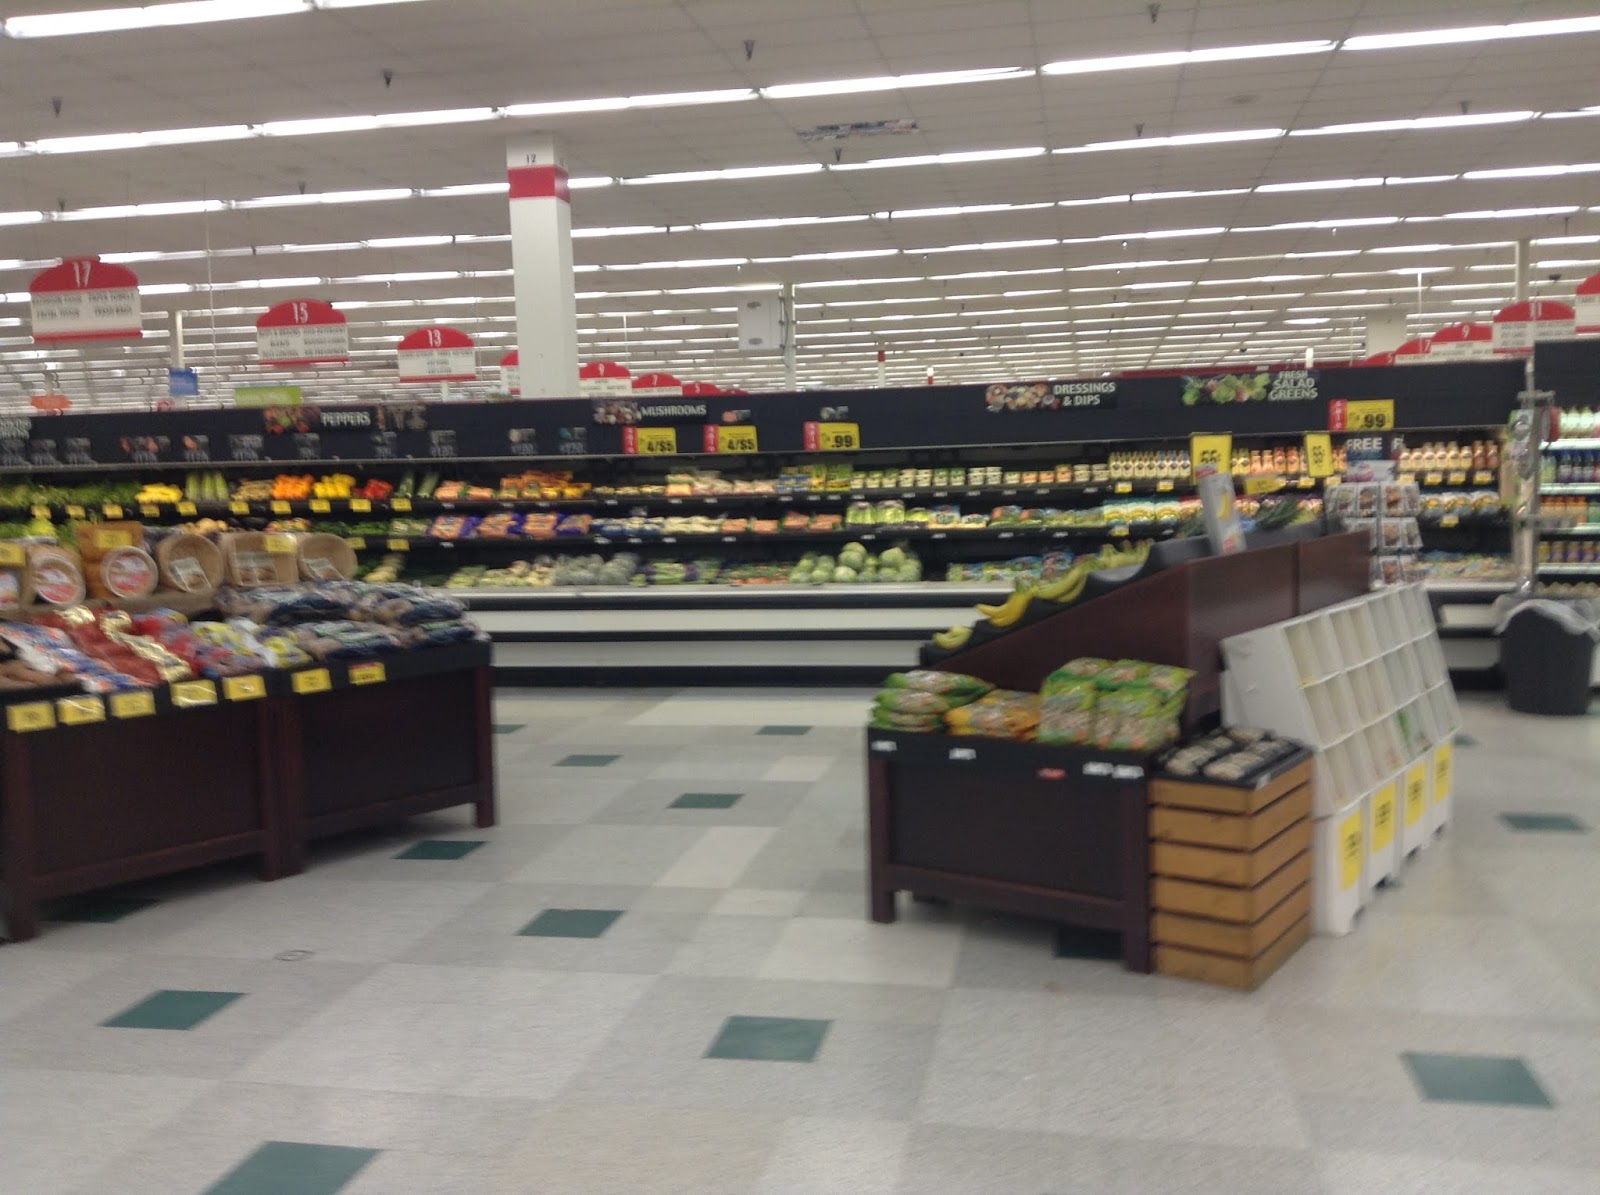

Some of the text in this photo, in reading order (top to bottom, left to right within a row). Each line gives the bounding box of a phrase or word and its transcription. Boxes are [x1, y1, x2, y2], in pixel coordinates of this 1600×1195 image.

[73, 260, 91, 288] 17
[292, 302, 309, 324] 15
[427, 329, 442, 347] 13
[1461, 325, 1471, 338] 9
[598, 363, 605, 376] 9
[1278, 370, 1308, 379] FRESH
[1053, 382, 1117, 395] DRESSINGS
[1272, 378, 1315, 389] SALAD
[1061, 394, 1101, 406] & DIPS
[1268, 387, 1319, 400] GREENS
[640, 404, 707, 417] MUSHROOMS
[320, 411, 371, 426] PEPPERS
[1360, 413, 1386, 428] .99
[831, 434, 853, 448] .99
[1346, 438, 1383, 450] FREE
